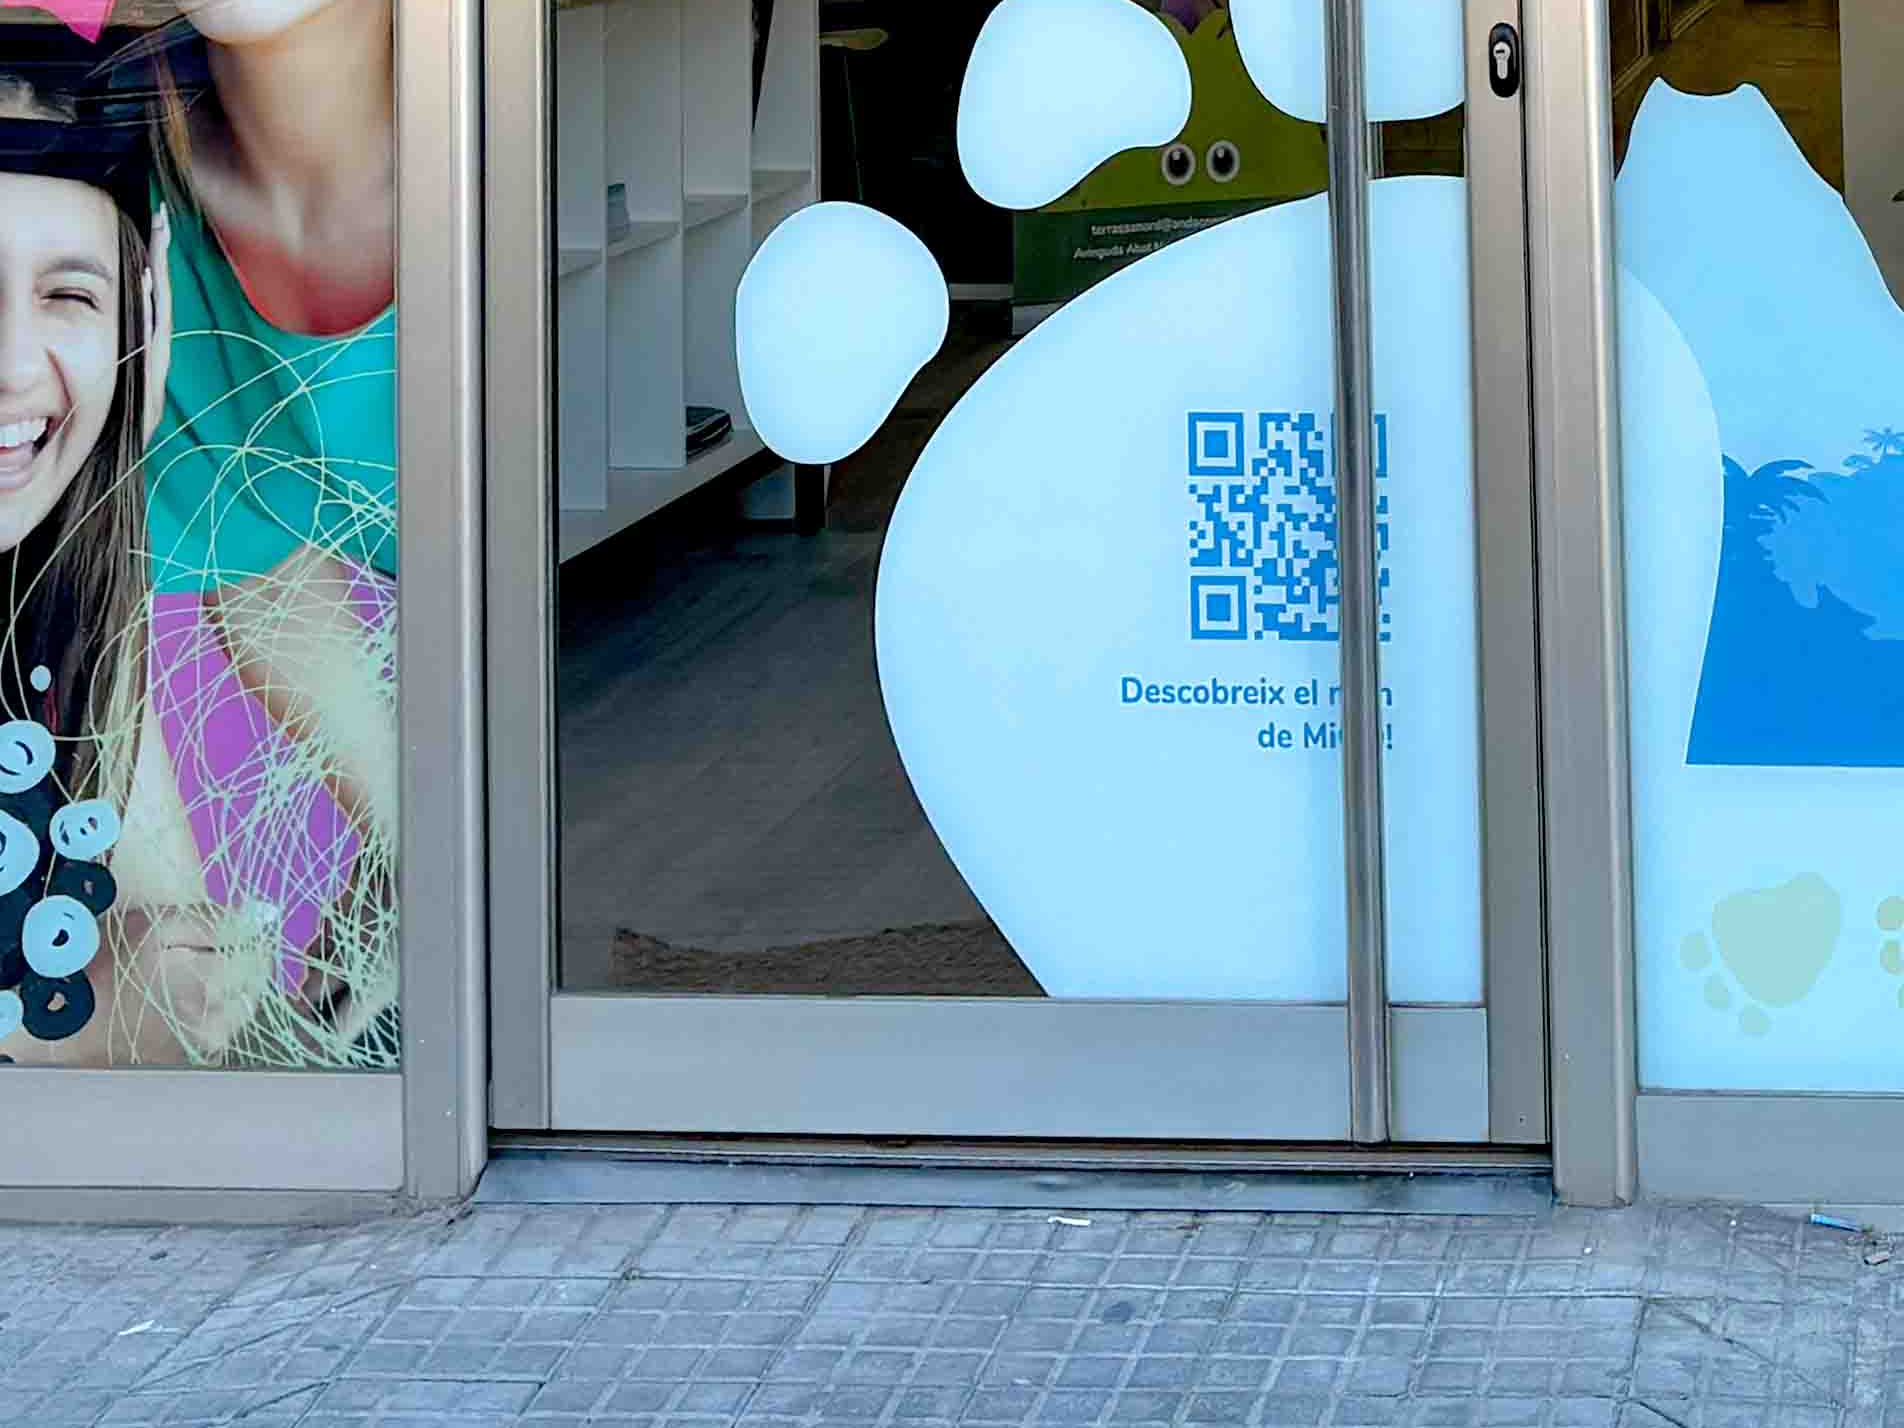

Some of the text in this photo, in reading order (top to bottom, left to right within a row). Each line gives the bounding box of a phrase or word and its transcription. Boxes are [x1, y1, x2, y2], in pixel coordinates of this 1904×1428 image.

[1121, 676, 1286, 706] Descobreix
[1294, 678, 1319, 706] el
[1257, 721, 1293, 749] de
